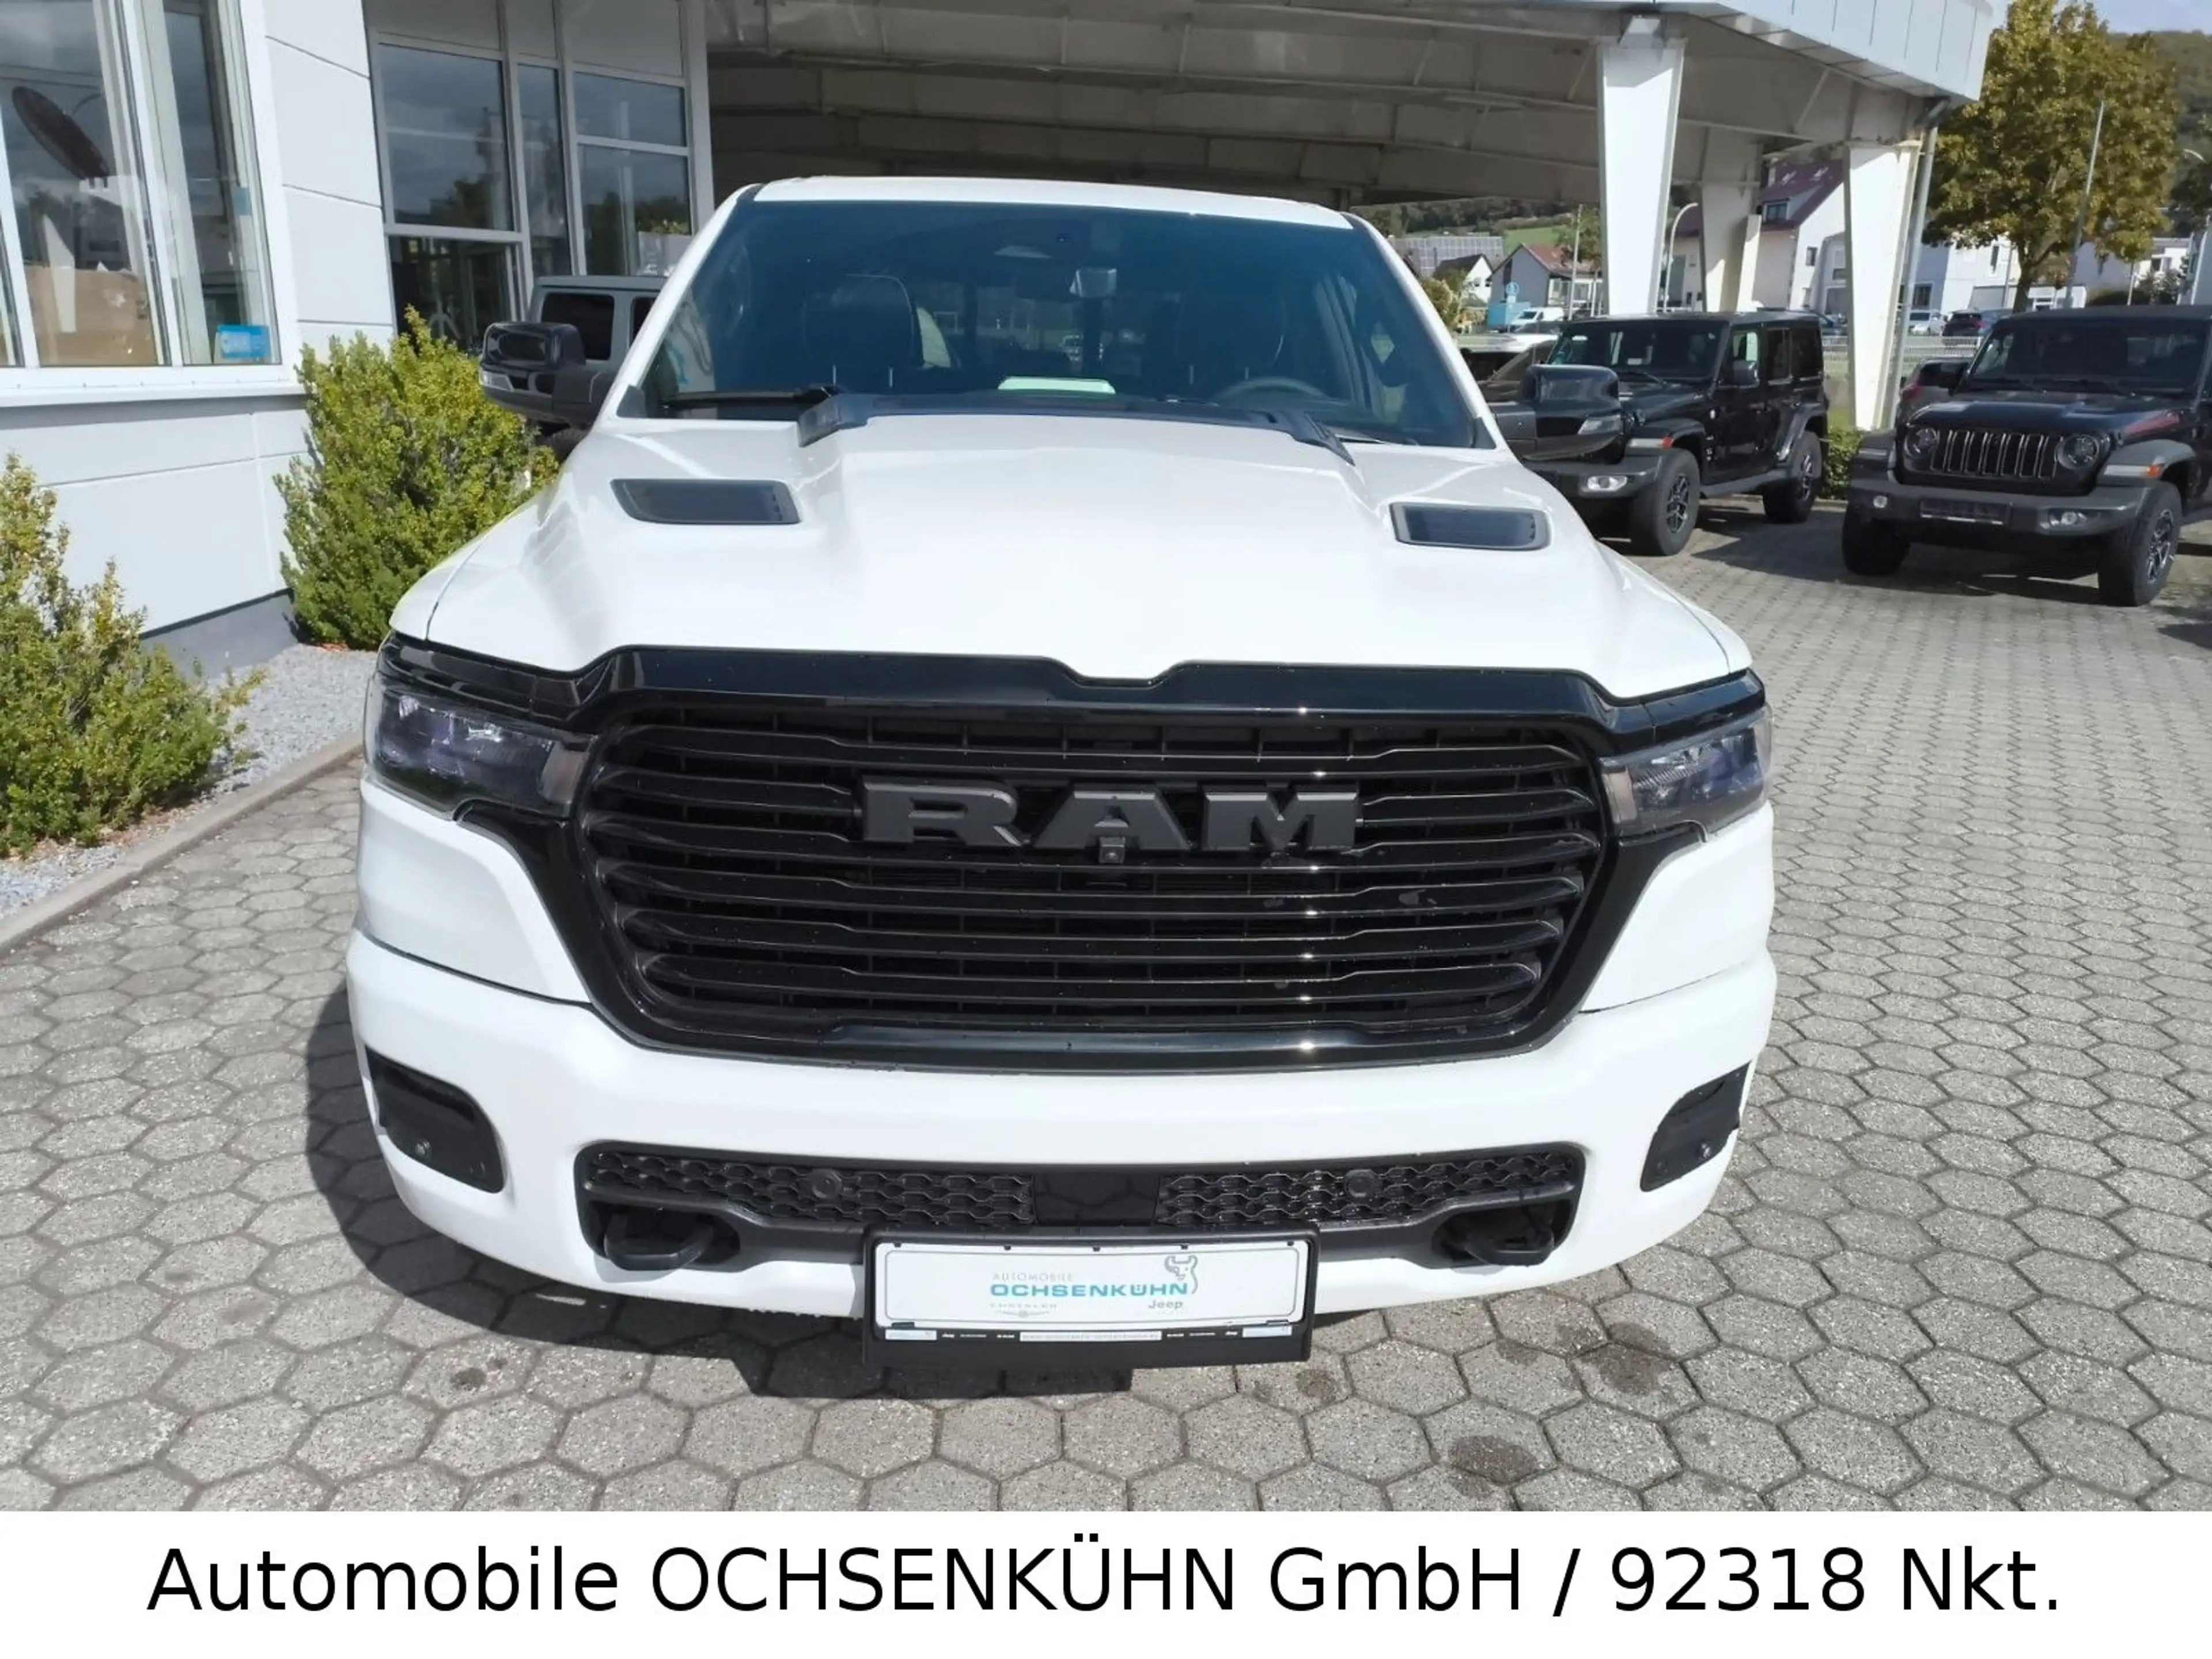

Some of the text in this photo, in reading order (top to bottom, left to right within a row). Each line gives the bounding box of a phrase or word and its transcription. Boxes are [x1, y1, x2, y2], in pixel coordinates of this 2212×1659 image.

[861, 781, 1361, 851] RAM
[990, 1283, 1188, 1297] OCHSENKÜHN
[1148, 1300, 1183, 1310] Jeep
